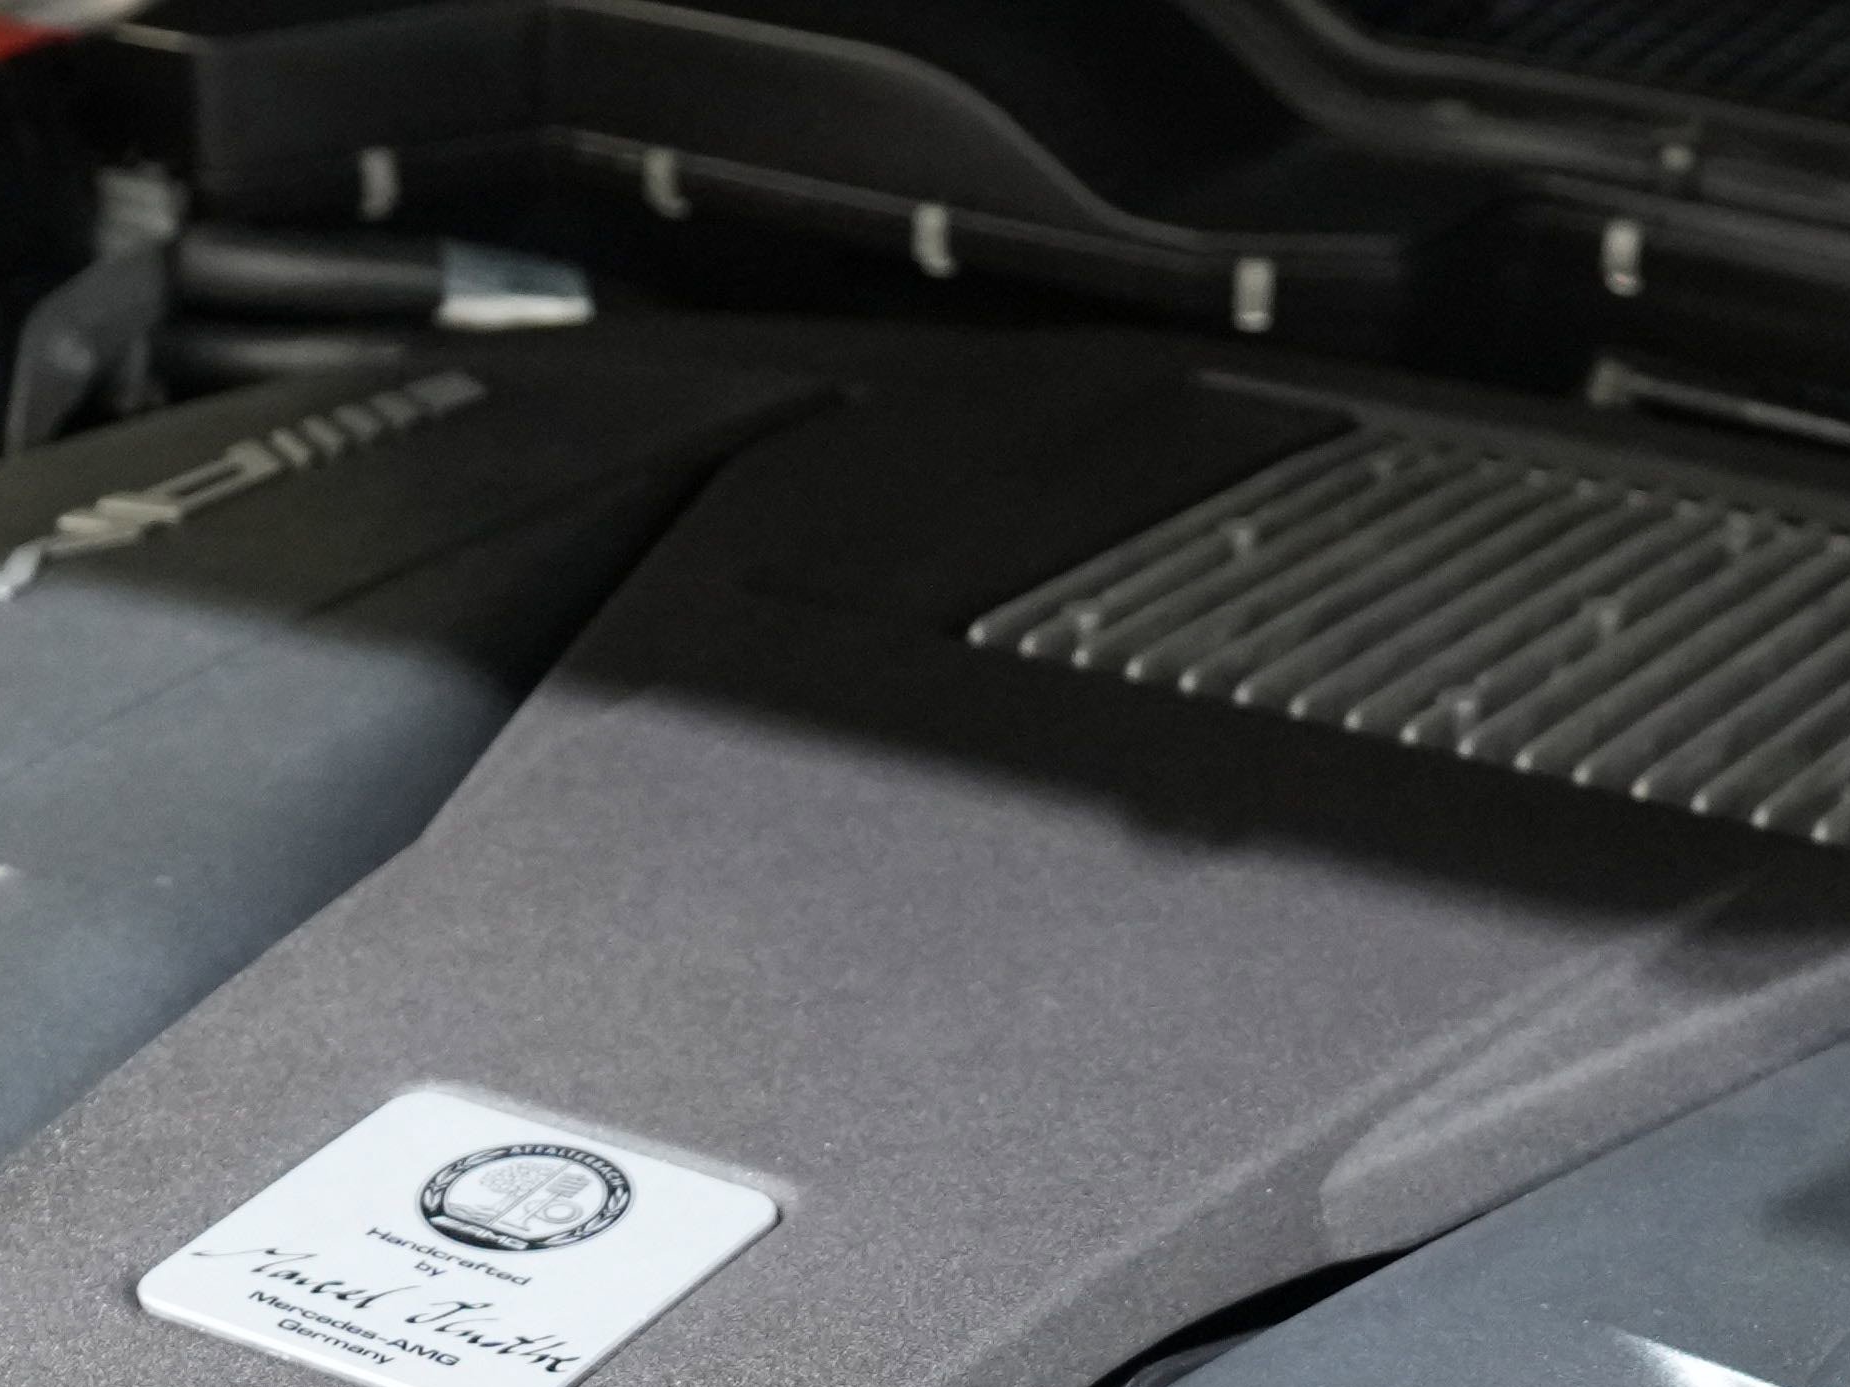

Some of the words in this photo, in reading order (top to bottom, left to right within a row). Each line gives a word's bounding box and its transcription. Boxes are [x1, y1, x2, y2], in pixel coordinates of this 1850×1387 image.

[366, 1226, 533, 1287] Handcrafted
[414, 1260, 447, 1278] by
[248, 1290, 461, 1366] Mercedes-AMG
[277, 1318, 395, 1365] Germany
